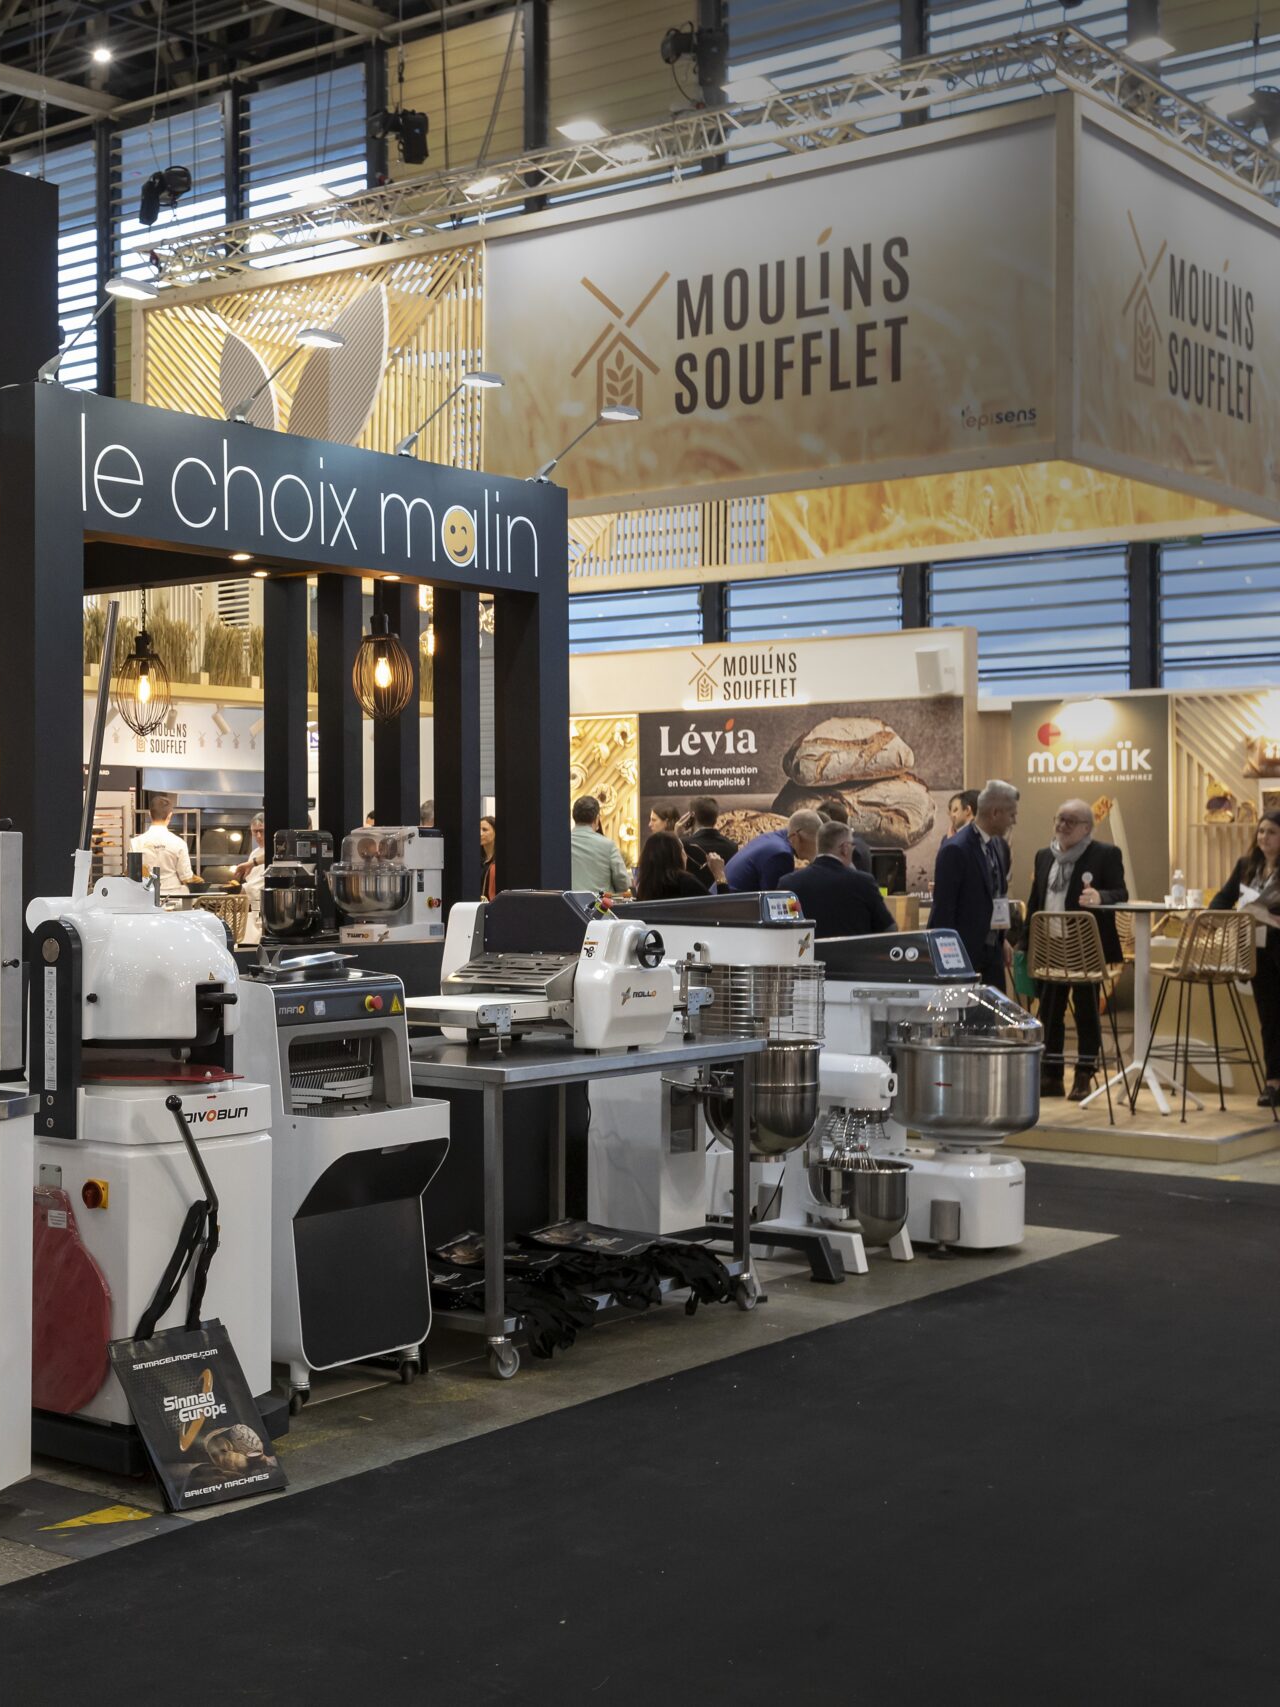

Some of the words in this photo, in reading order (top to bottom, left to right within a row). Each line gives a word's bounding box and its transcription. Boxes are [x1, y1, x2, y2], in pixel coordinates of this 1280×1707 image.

[676, 234, 910, 340] MOULINS
[1170, 253, 1254, 351] MOULINS
[675, 315, 909, 415] SOUFFLET
[1168, 331, 1254, 424] SOUFFLET
[81, 412, 144, 518] le
[171, 438, 358, 551] choix
[380, 488, 539, 578] malin
[723, 649, 797, 677] MOULINS
[723, 678, 797, 701] SOUFFLET
[150, 738, 187, 755] SOUFFLET
[660, 720, 758, 757] Lévia
[1027, 740, 1152, 773] mozaïk
[668, 780, 678, 788] en
[680, 778, 702, 787] toute
[704, 776, 746, 789] simplicité
[681, 767, 691, 775] de
[693, 767, 700, 775] la
[702, 765, 758, 776] fermentation
[632, 990, 657, 999] ROLLO
[183, 1106, 249, 1124] DIVOBUN
[163, 1391, 215, 1412] Sinmag
[178, 1403, 227, 1423] Europe
[184, 1484, 223, 1498] BAKERY
[224, 1473, 270, 1489] MACHINES
